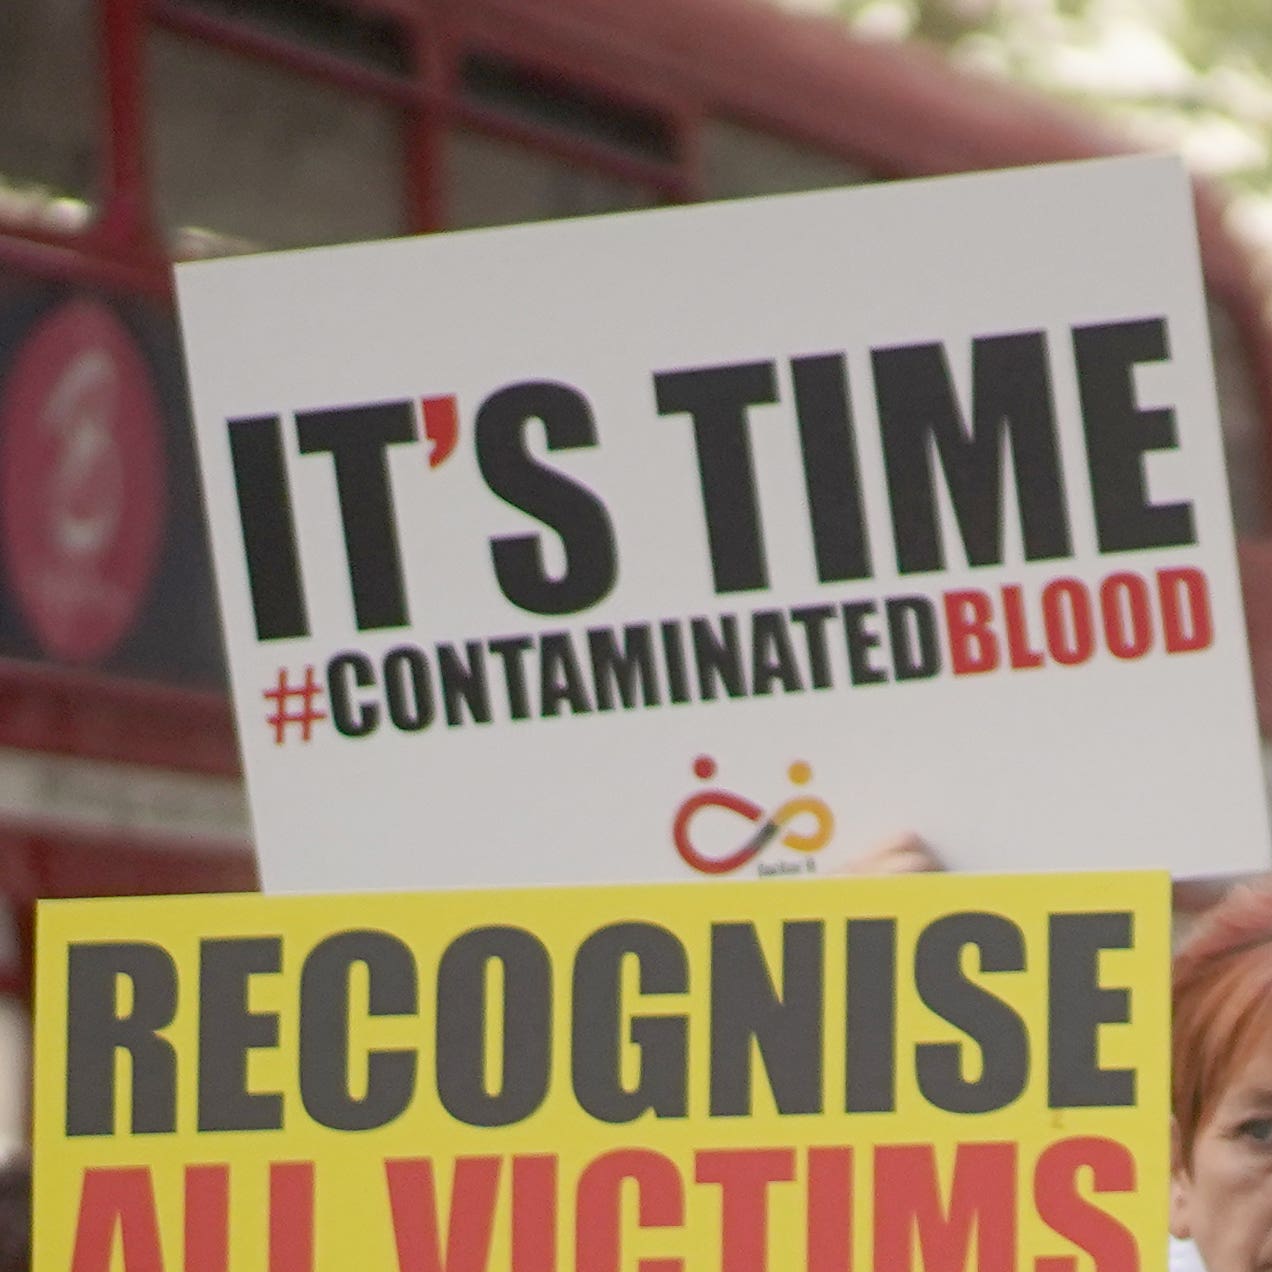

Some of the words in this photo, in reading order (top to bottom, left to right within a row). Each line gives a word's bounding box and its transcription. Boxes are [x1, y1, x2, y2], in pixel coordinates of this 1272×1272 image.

[226, 381, 618, 642] IT'S
[652, 316, 1198, 594] TIME
[264, 568, 1214, 744] #CONTAMINATEDBLOOD
[64, 911, 1137, 1137] RECOGNISE
